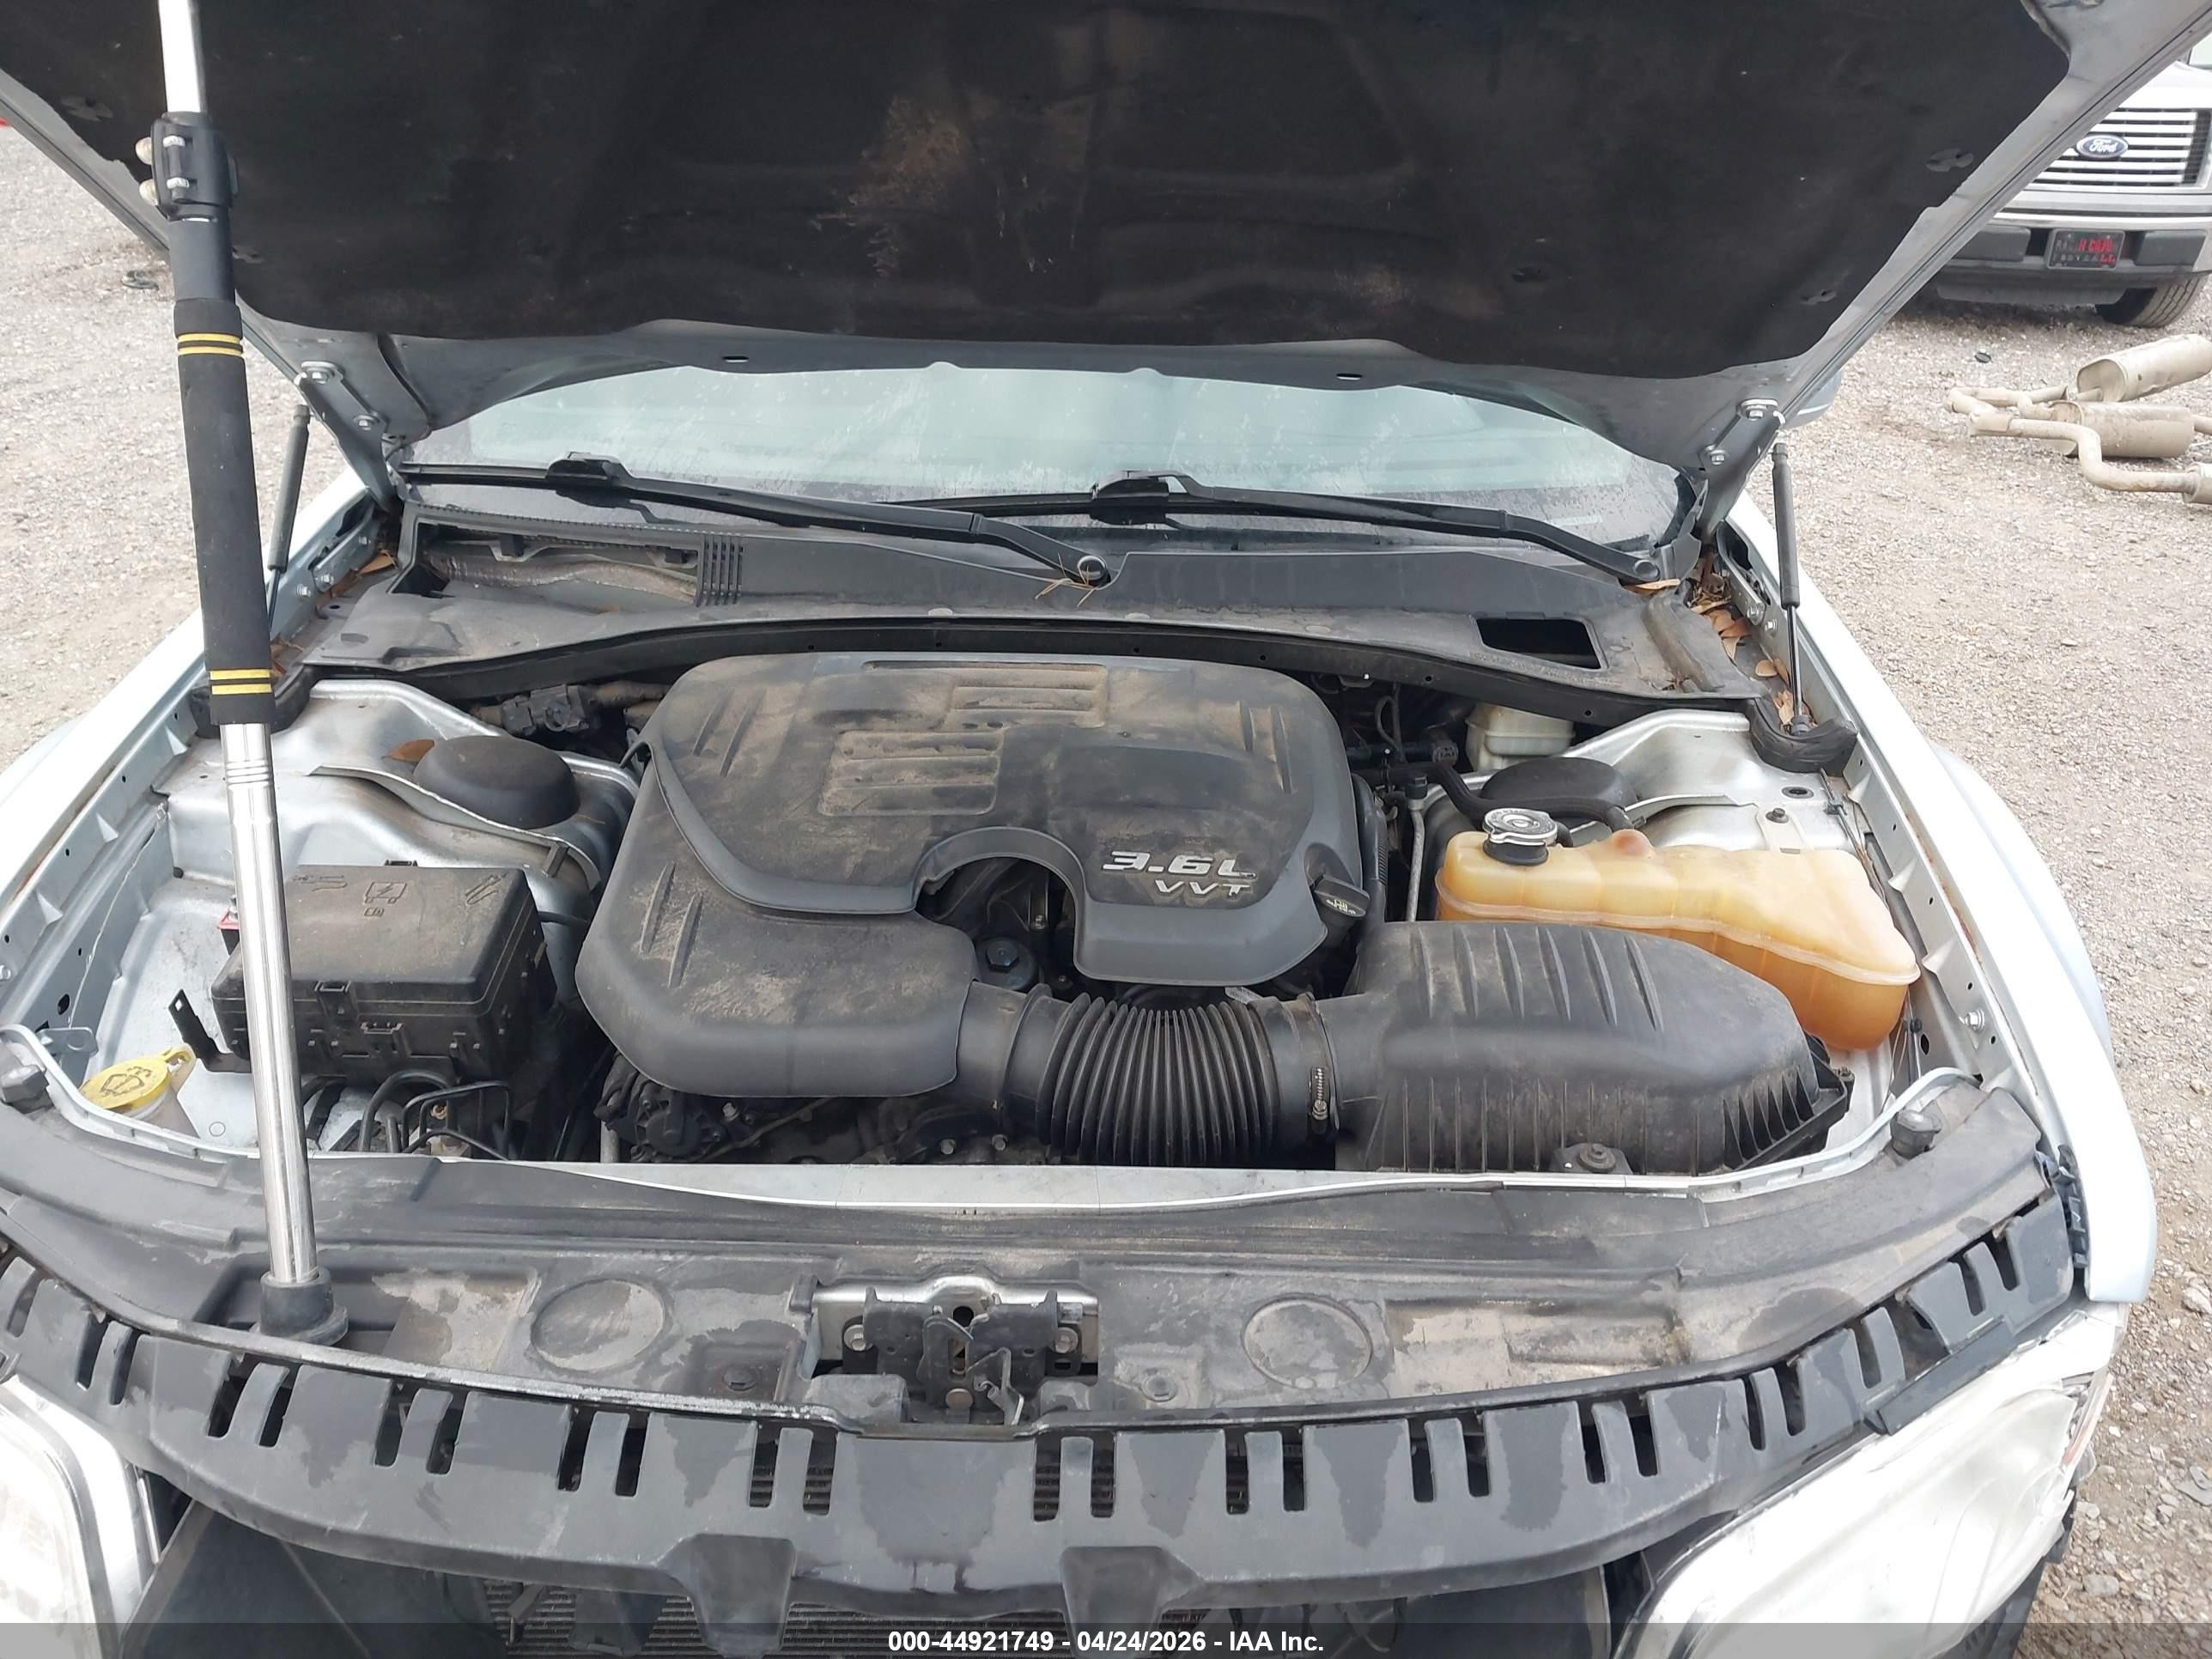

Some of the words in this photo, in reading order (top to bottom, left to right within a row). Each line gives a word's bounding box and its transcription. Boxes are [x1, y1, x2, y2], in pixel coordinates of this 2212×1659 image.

[2088, 139, 2118, 153] Ford
[1103, 850, 1256, 878] 3.6L
[1155, 878, 1251, 896] VVT
